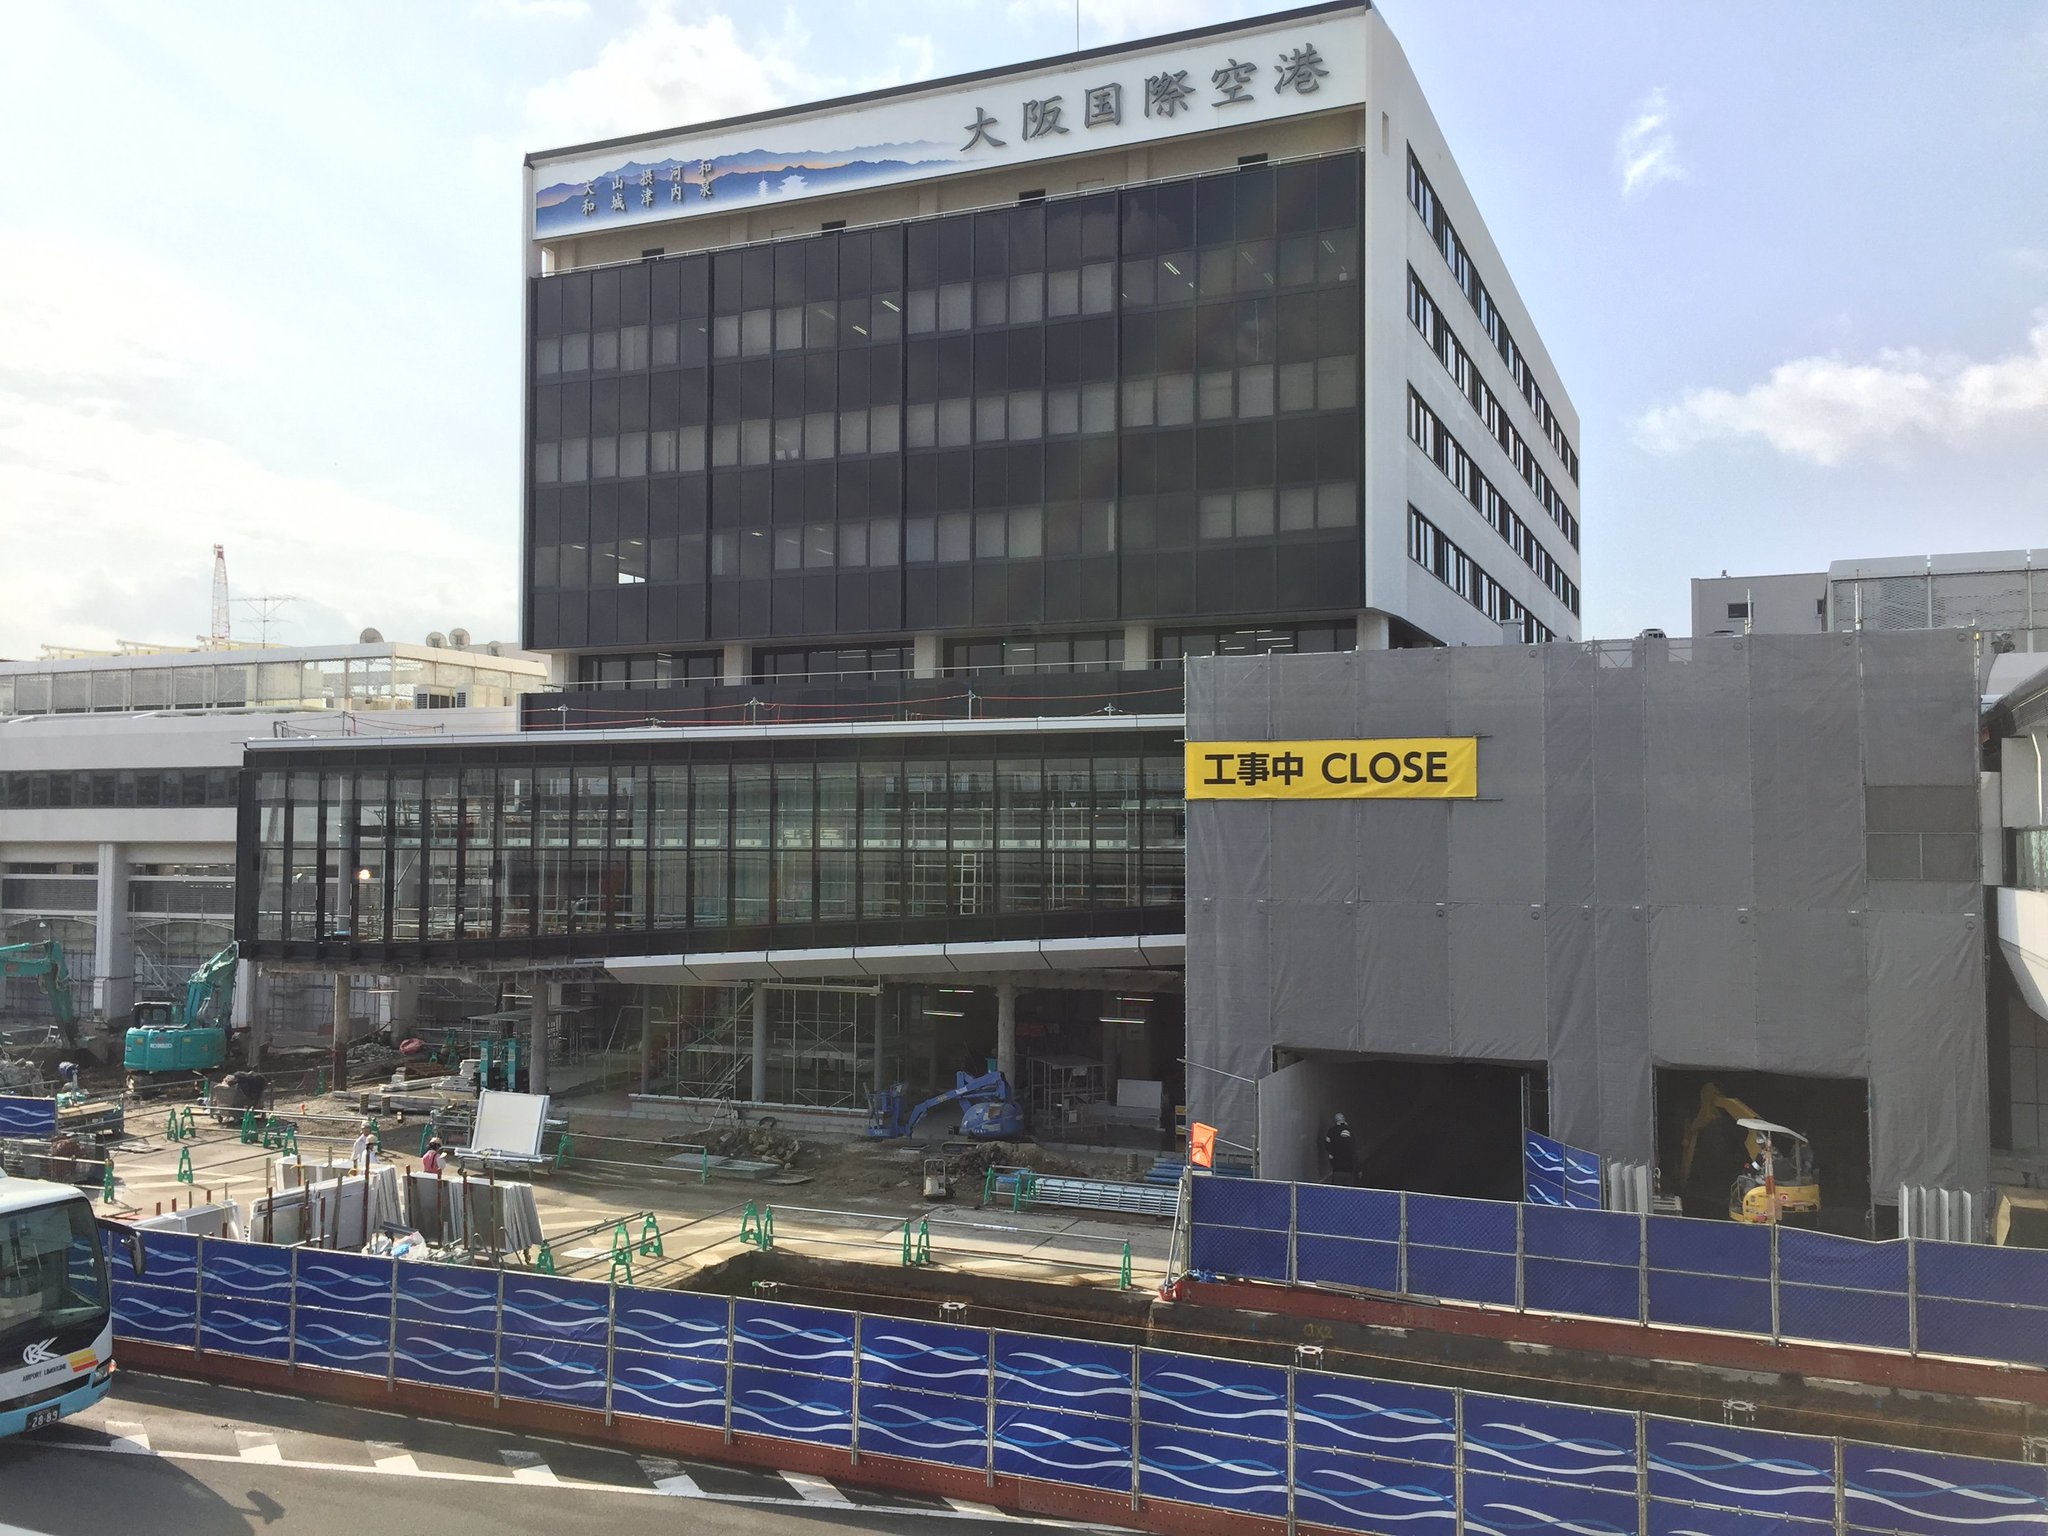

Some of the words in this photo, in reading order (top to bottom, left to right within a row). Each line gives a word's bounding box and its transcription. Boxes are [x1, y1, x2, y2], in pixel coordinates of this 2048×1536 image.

[960, 42, 1330, 152] 大阪国際空港
[612, 176, 625, 212] 山城
[641, 170, 655, 207] 摂津
[670, 165, 683, 202] 河内
[698, 160, 713, 198] 和泉
[583, 180, 596, 216] 大和
[1203, 751, 1304, 786] 工事中
[1321, 751, 1448, 784] CLOSE
[22, 1370, 42, 1382] AIRPORT
